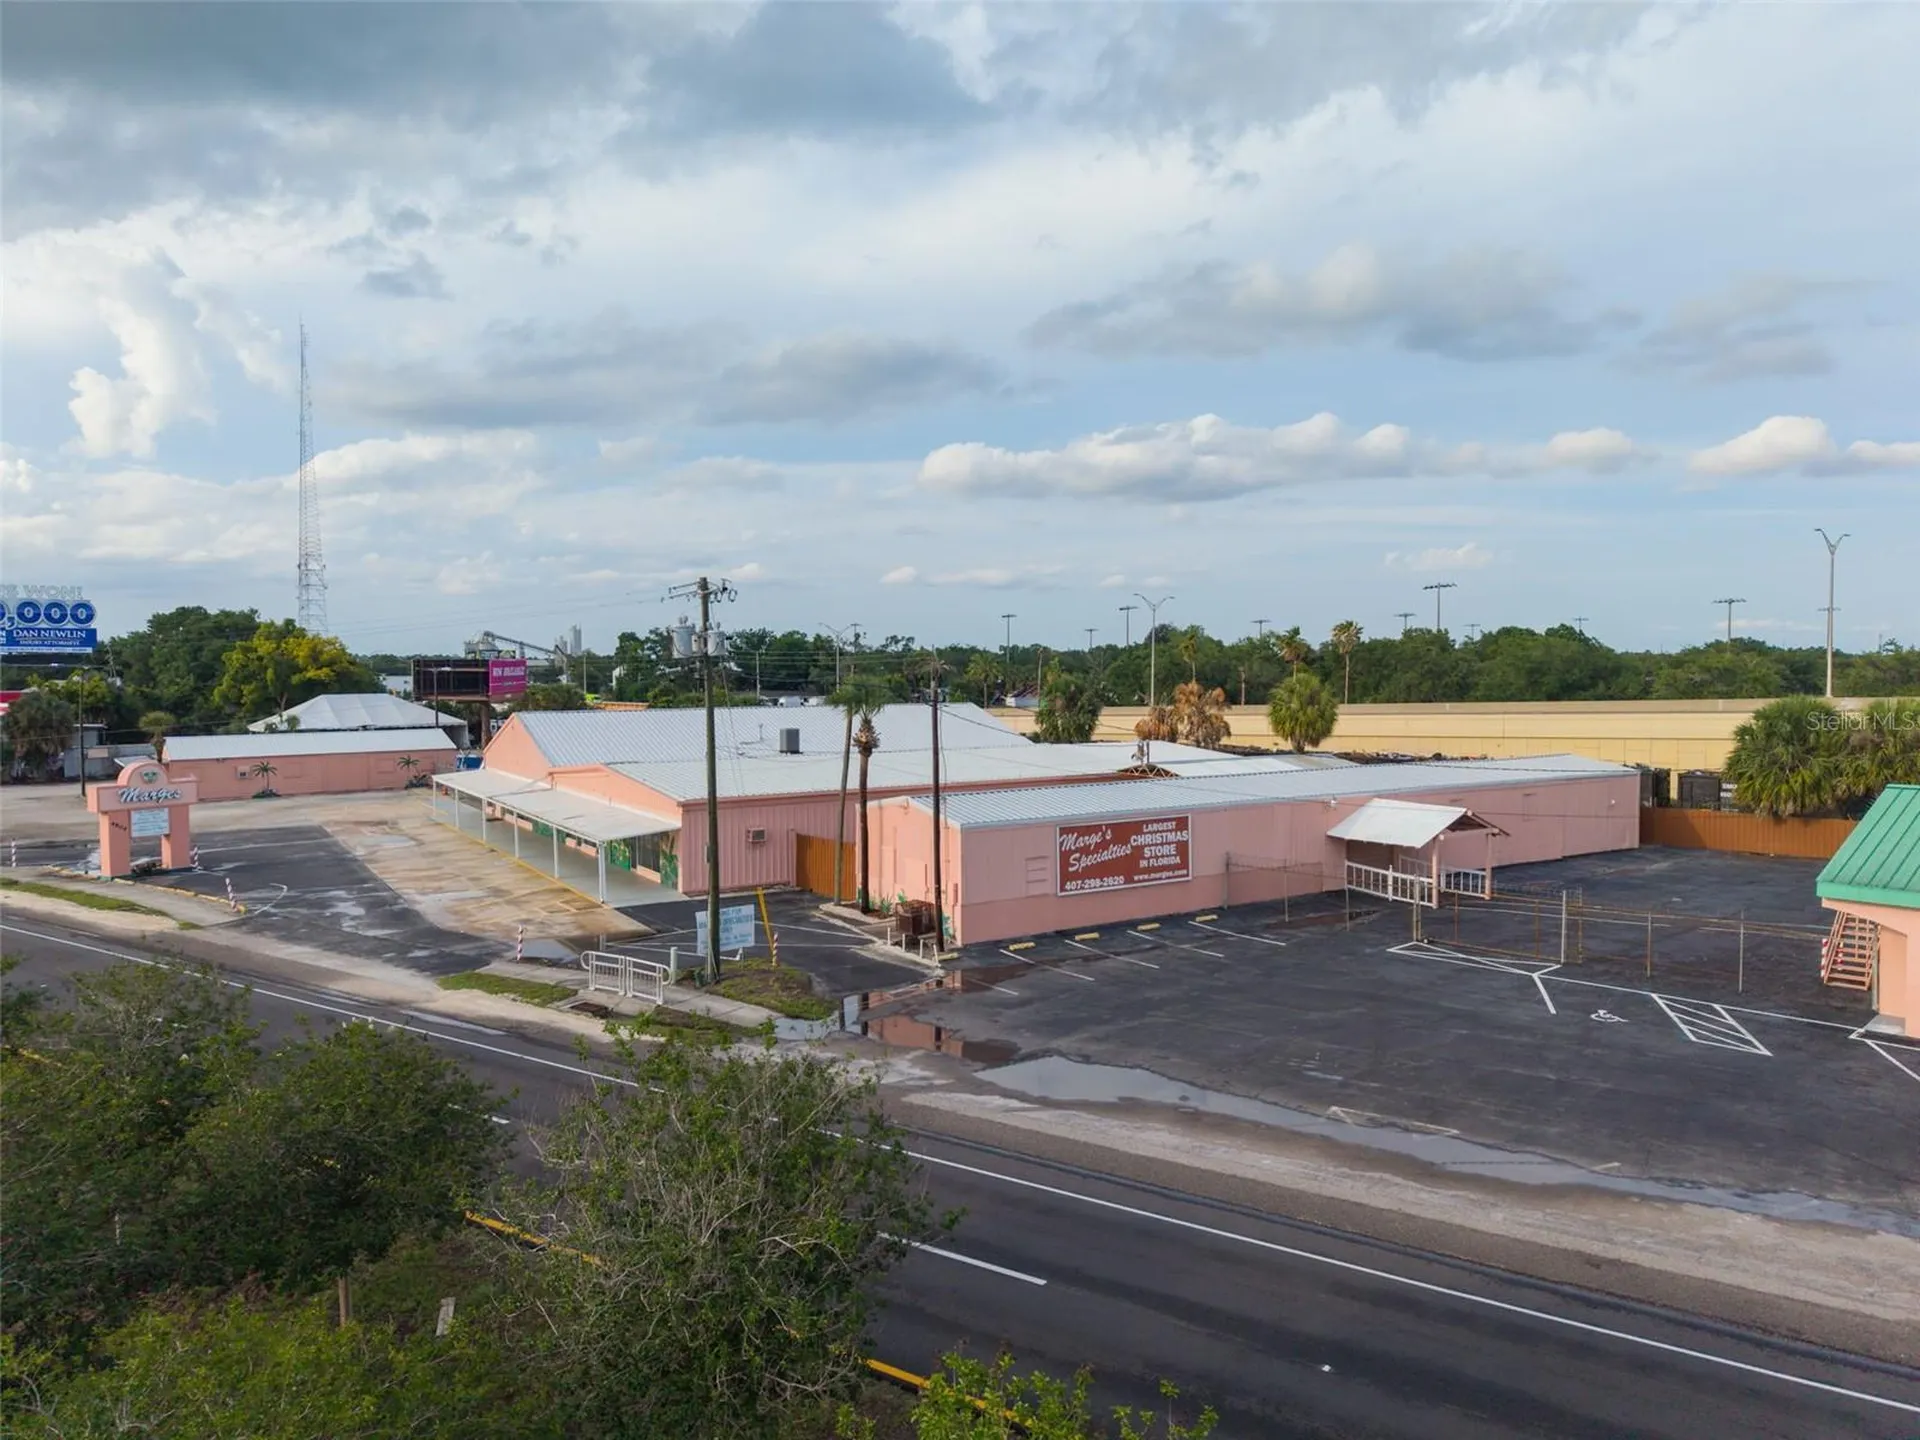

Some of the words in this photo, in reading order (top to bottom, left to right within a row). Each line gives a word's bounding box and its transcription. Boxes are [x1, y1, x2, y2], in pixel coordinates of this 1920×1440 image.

[0, 600, 96, 629] ,000
[13, 629, 38, 638] DAN
[40, 630, 86, 639] NEWLIN
[1143, 821, 1176, 832] LARGEST
[1060, 825, 1112, 851] Marge's
[1130, 830, 1189, 846] CHRISTMAS
[1068, 843, 1132, 872] Specialties
[1144, 844, 1177, 858] STORE
[1140, 859, 1149, 868] IN
[1150, 856, 1181, 867] FLORIDA
